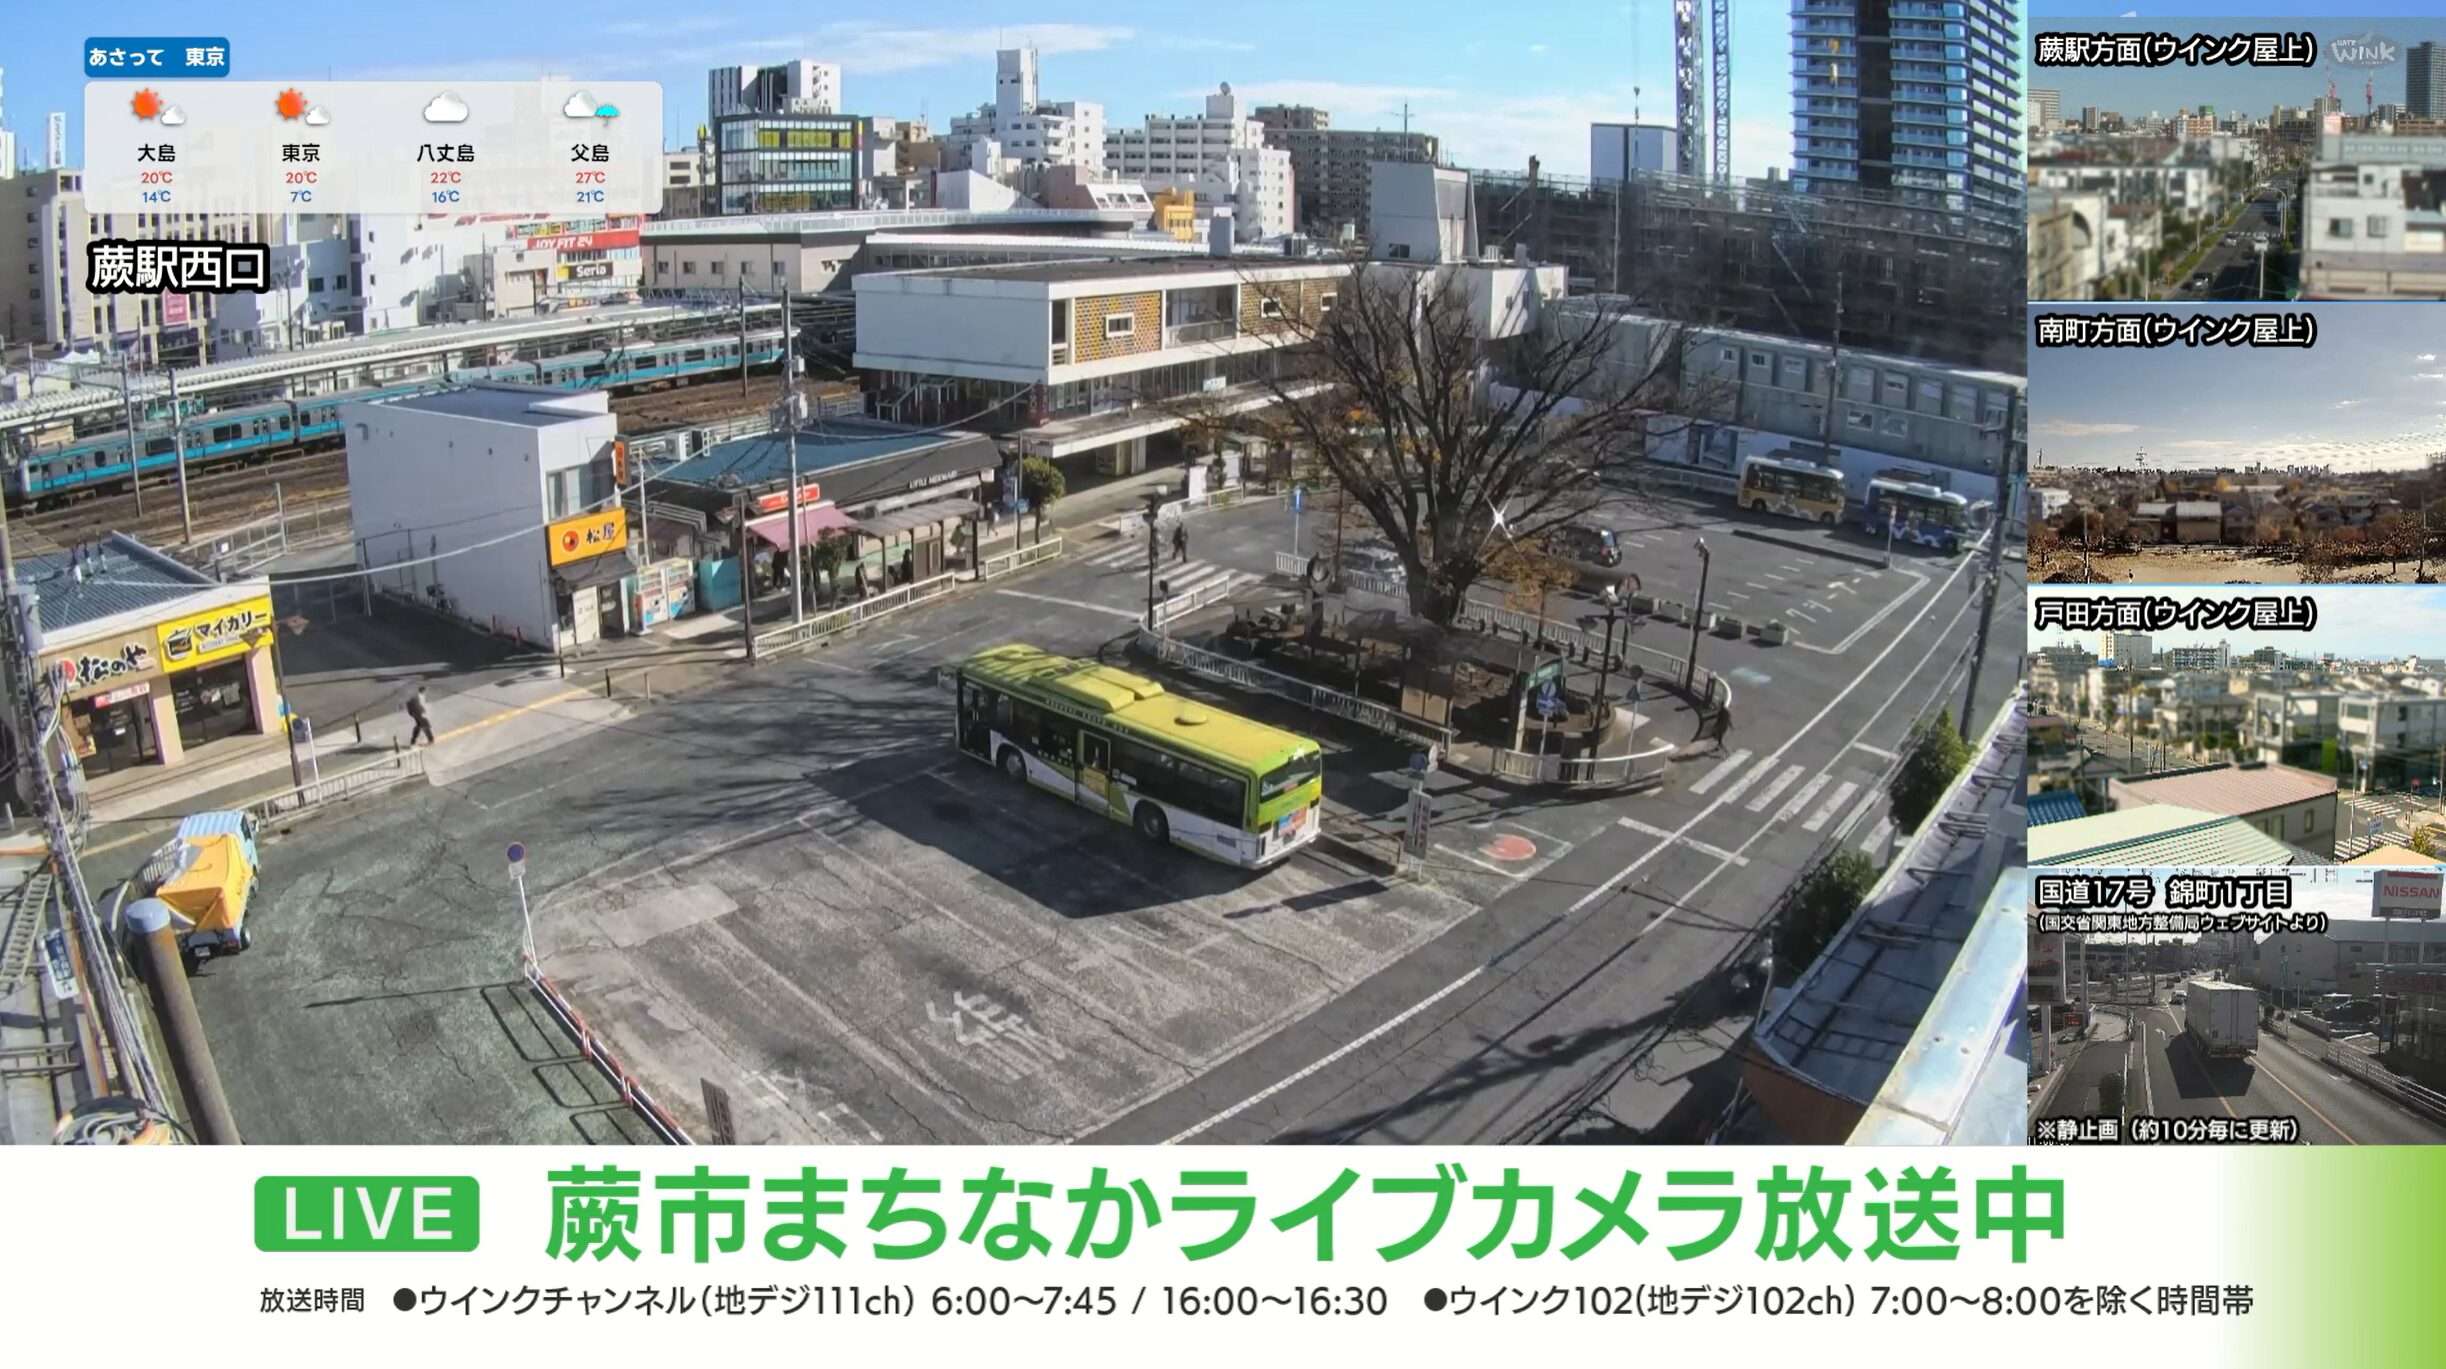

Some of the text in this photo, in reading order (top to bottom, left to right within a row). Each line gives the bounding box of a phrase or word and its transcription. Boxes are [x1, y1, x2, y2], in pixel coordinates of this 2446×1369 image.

[576, 263, 607, 278] Seria
[197, 610, 267, 637] マイカリー
[80, 645, 147, 683] 松のや
[2383, 885, 2442, 897] NISSAN
